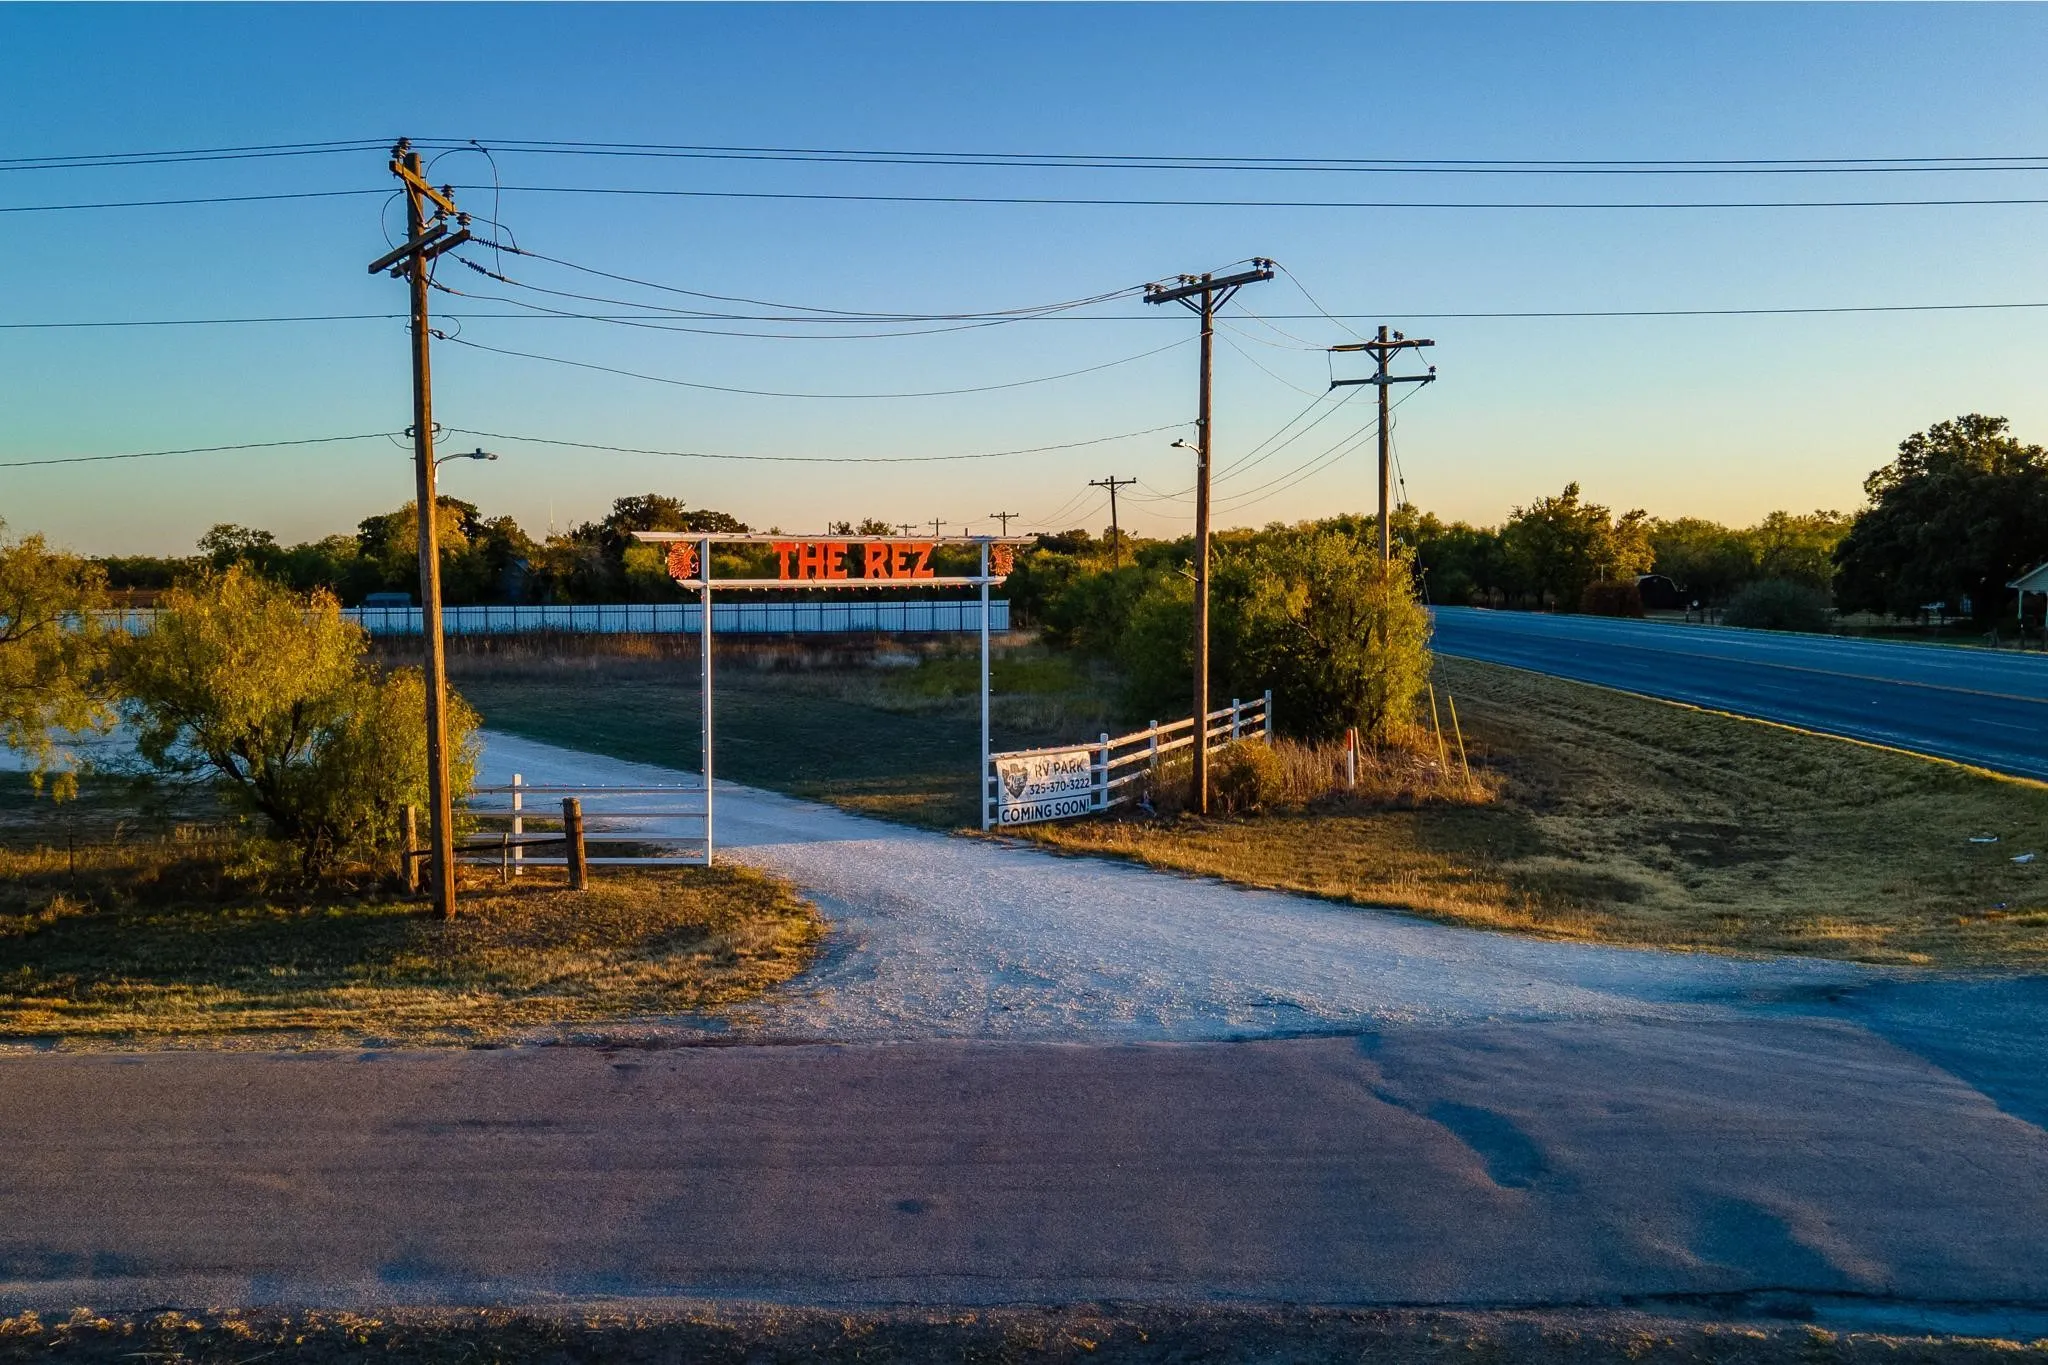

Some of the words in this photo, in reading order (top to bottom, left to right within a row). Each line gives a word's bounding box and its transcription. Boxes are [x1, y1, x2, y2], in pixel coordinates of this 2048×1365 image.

[772, 541, 848, 580] THE
[864, 541, 934, 579] REZ
[1035, 762, 1050, 777] RV
[1053, 759, 1084, 775] PARK
[1029, 778, 1090, 795] 325-370-3222
[1001, 804, 1052, 823] COMING
[1054, 798, 1090, 816] SOON!
